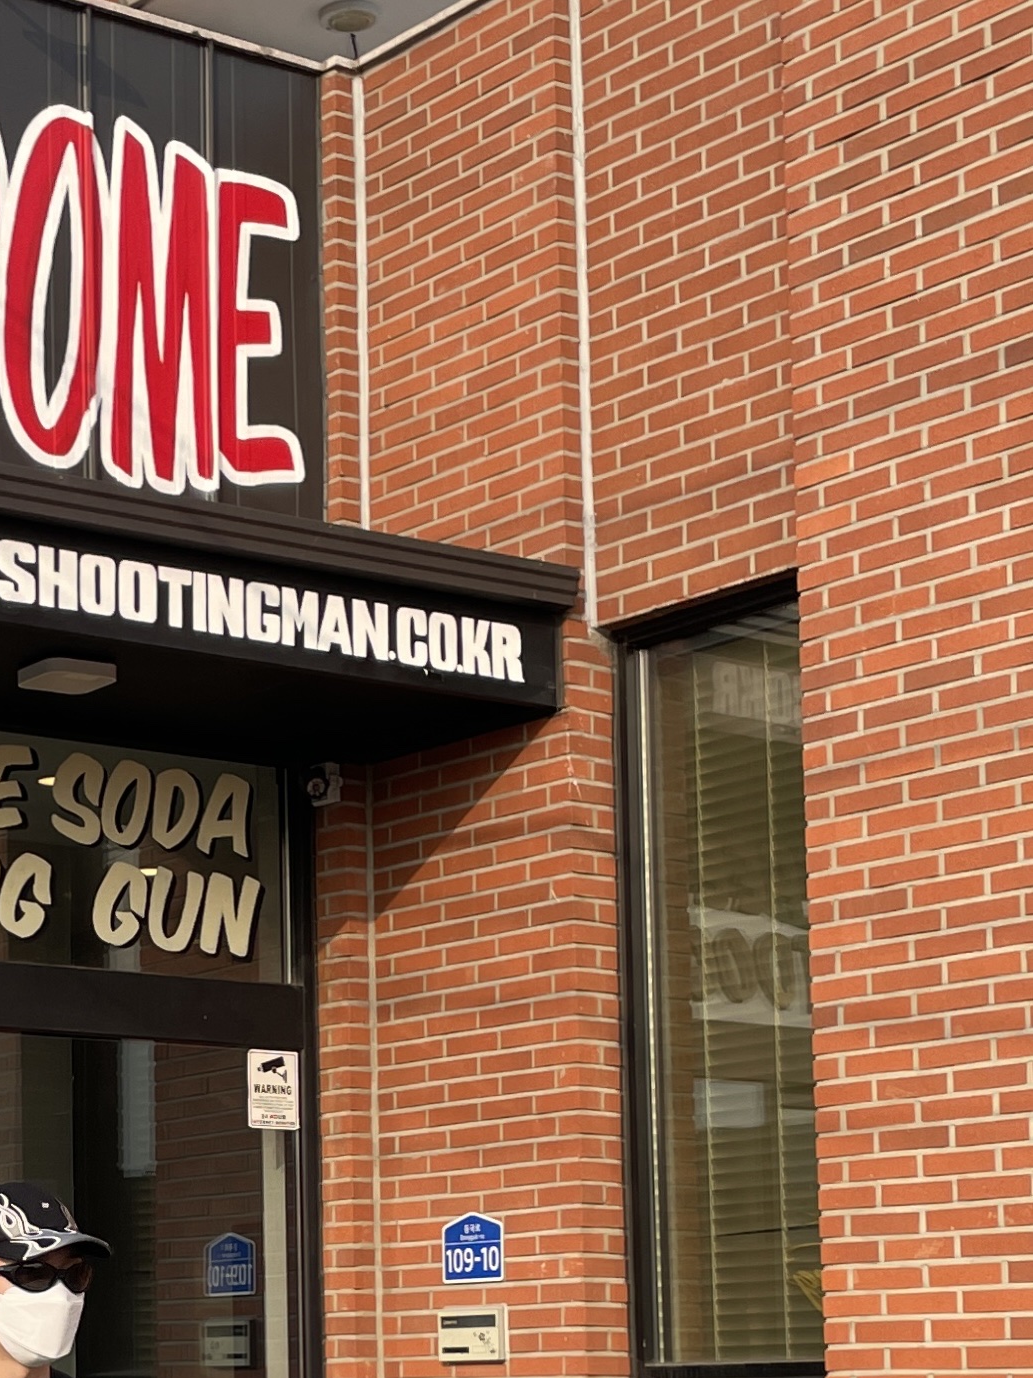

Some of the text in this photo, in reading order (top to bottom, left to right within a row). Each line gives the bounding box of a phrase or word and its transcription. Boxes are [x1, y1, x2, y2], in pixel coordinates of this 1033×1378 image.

[51, 752, 253, 860] SODA
[92, 861, 263, 958] GUN
[253, 1084, 292, 1096] WARNING
[446, 1245, 499, 1273] 109-10
